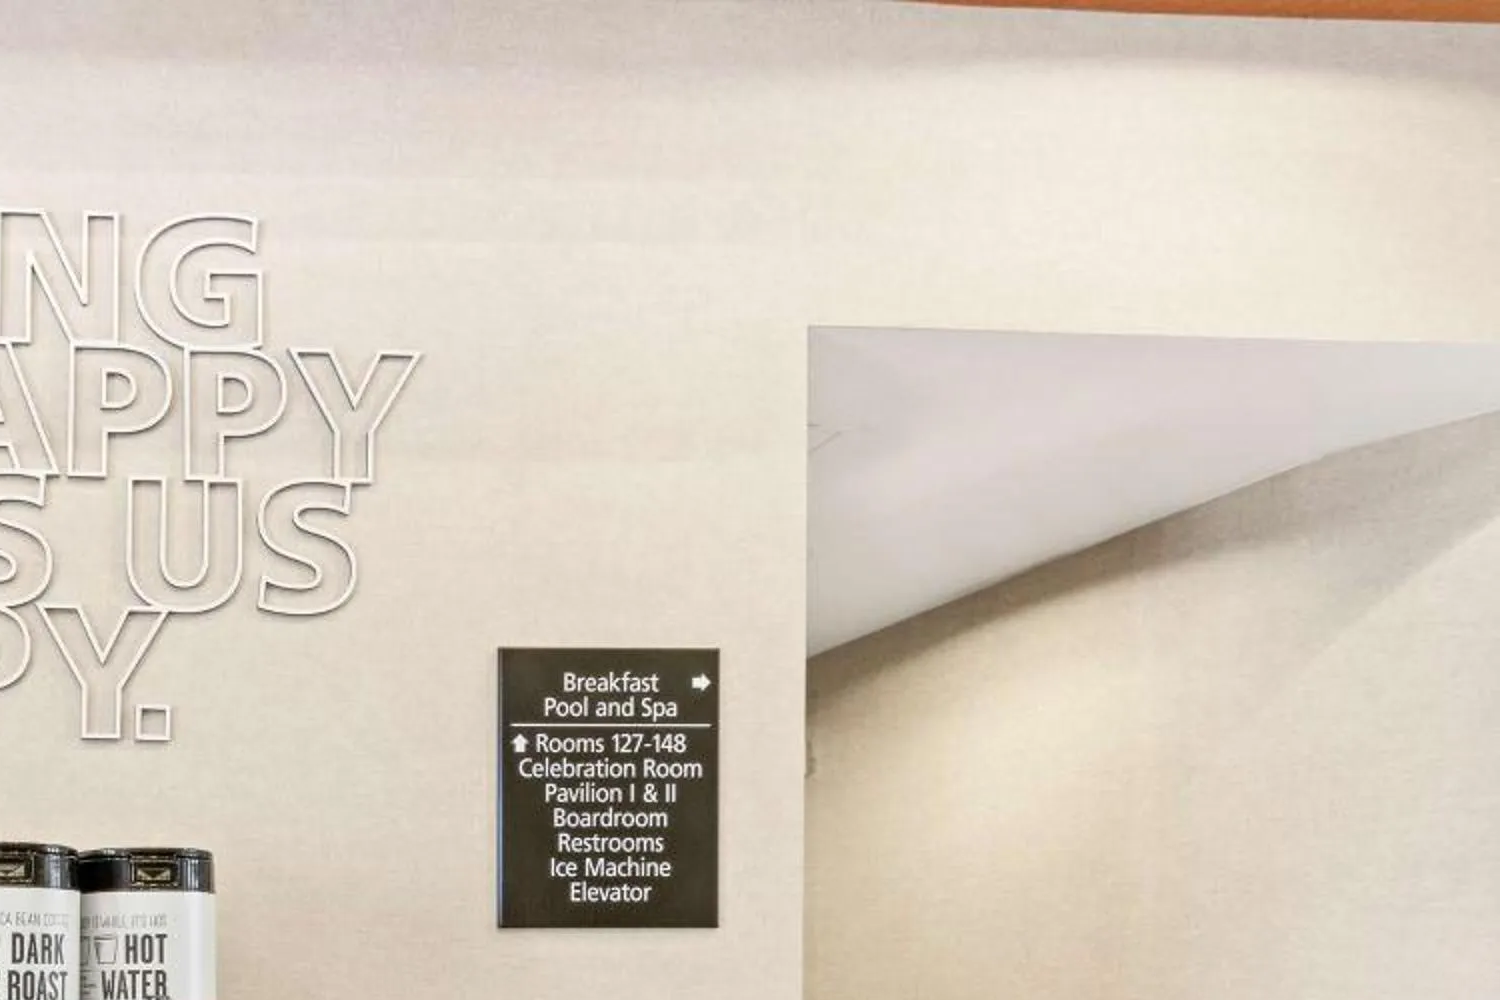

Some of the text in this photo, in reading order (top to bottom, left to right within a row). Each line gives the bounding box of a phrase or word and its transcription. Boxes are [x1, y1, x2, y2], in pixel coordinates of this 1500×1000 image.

[124, 476, 358, 616] US
[564, 671, 660, 692] Breakfast
[544, 696, 678, 722] Pool and Spa
[536, 733, 687, 753] Rooms 127-148
[519, 757, 702, 778] Celebration Room
[545, 782, 676, 803] Pavilion I & II
[554, 807, 668, 828] Boardroom
[558, 832, 664, 852] Restrooms
[551, 856, 671, 877] Ice Machine
[570, 881, 652, 902] Elevator
[11, 932, 66, 964] DARK
[125, 934, 168, 965] HOT
[101, 970, 168, 1000] WATER
